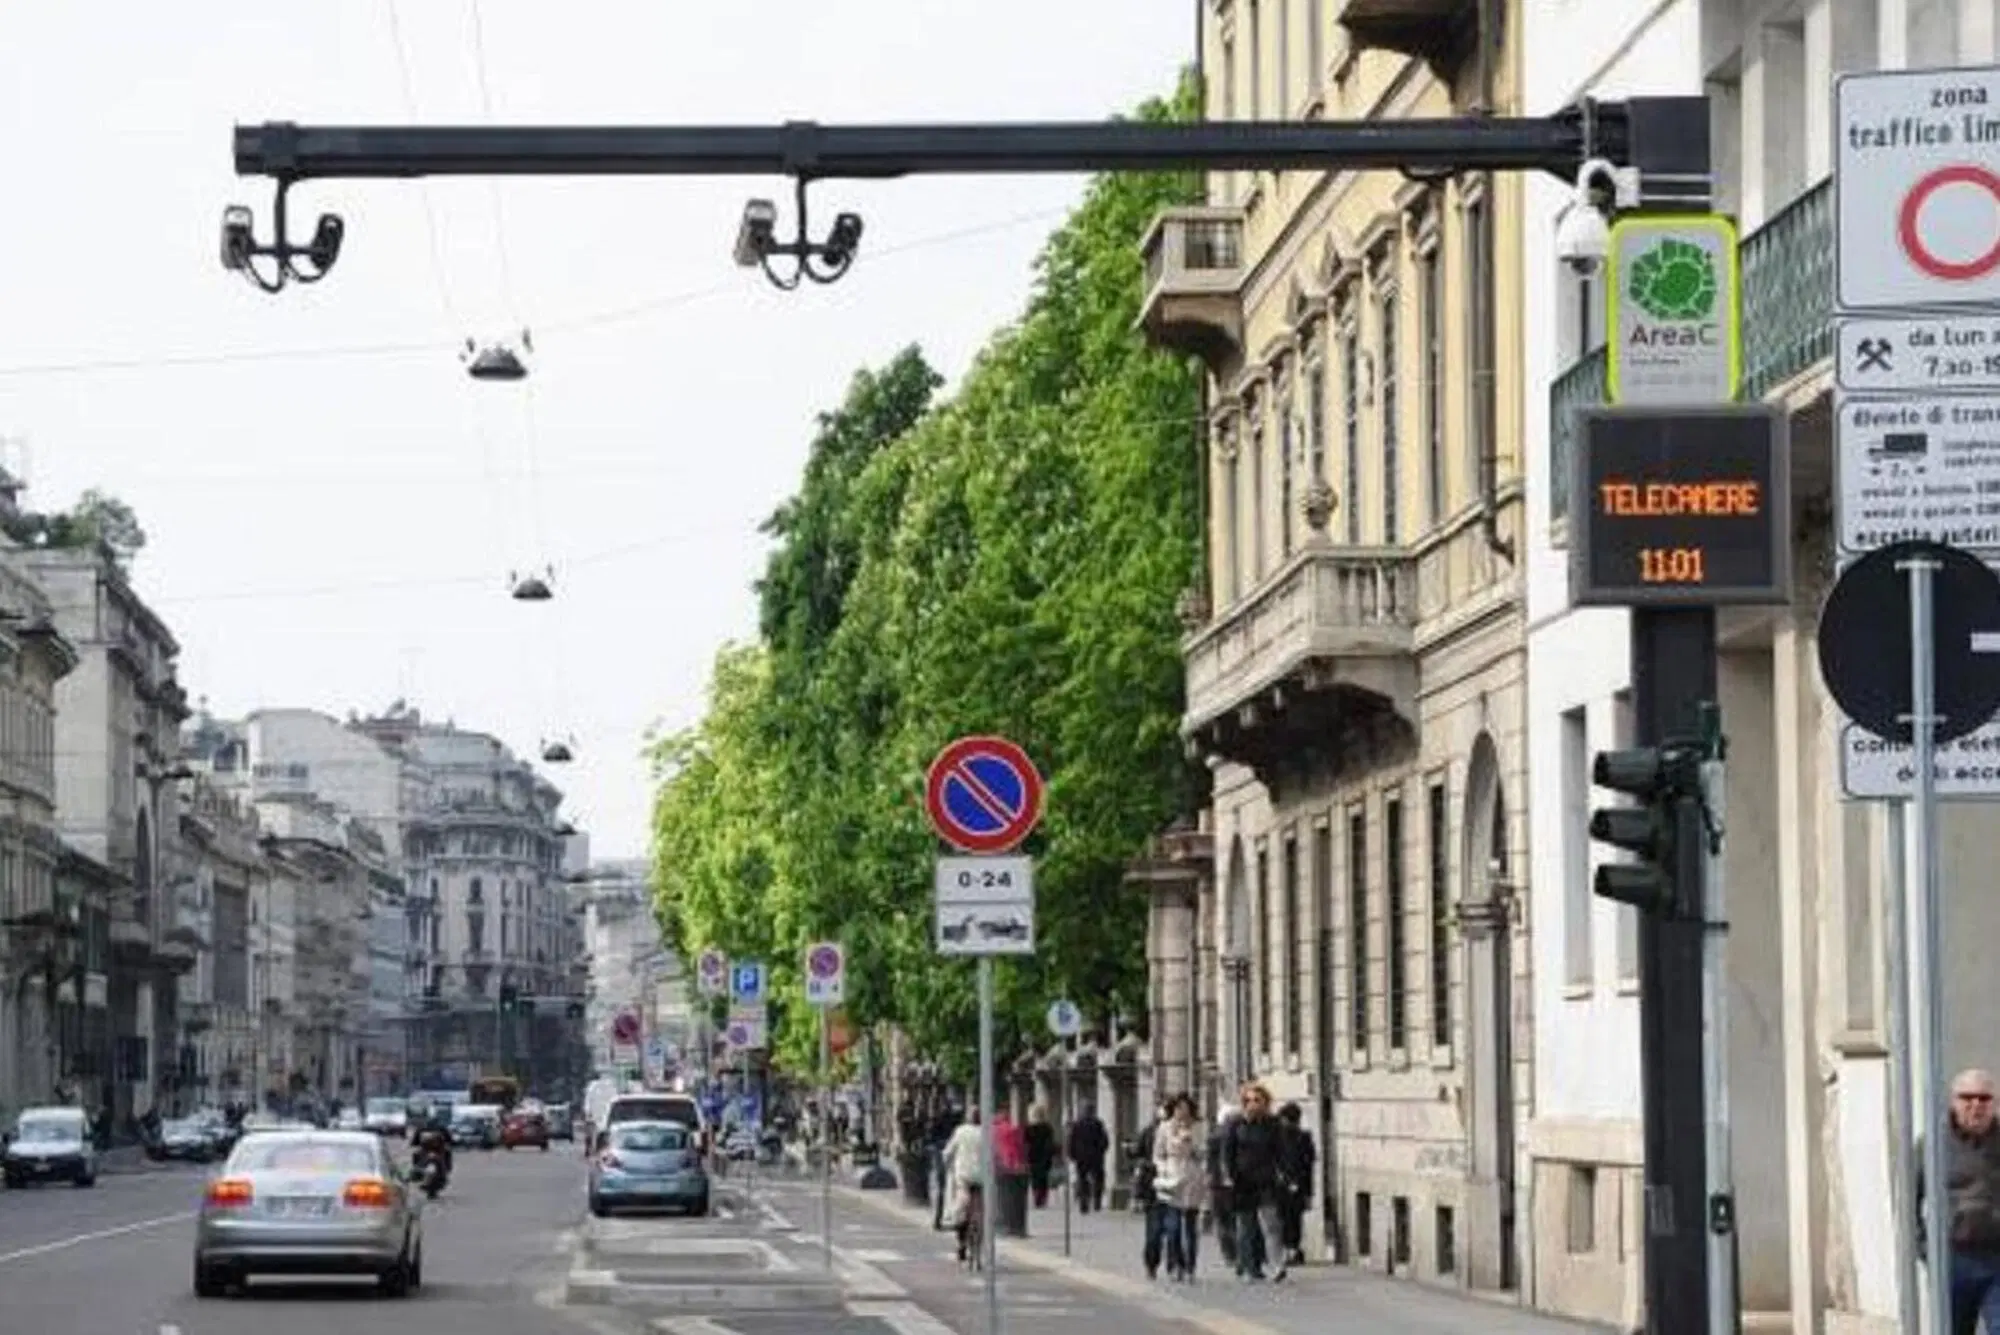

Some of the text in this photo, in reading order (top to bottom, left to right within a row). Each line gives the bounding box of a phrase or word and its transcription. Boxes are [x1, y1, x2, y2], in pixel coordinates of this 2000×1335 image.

[1931, 87, 1987, 108] zona
[1850, 117, 1952, 147] traffico
[1908, 328, 1935, 346] da
[1944, 327, 1985, 346] lun
[1600, 483, 1758, 516] TELECAMERE
